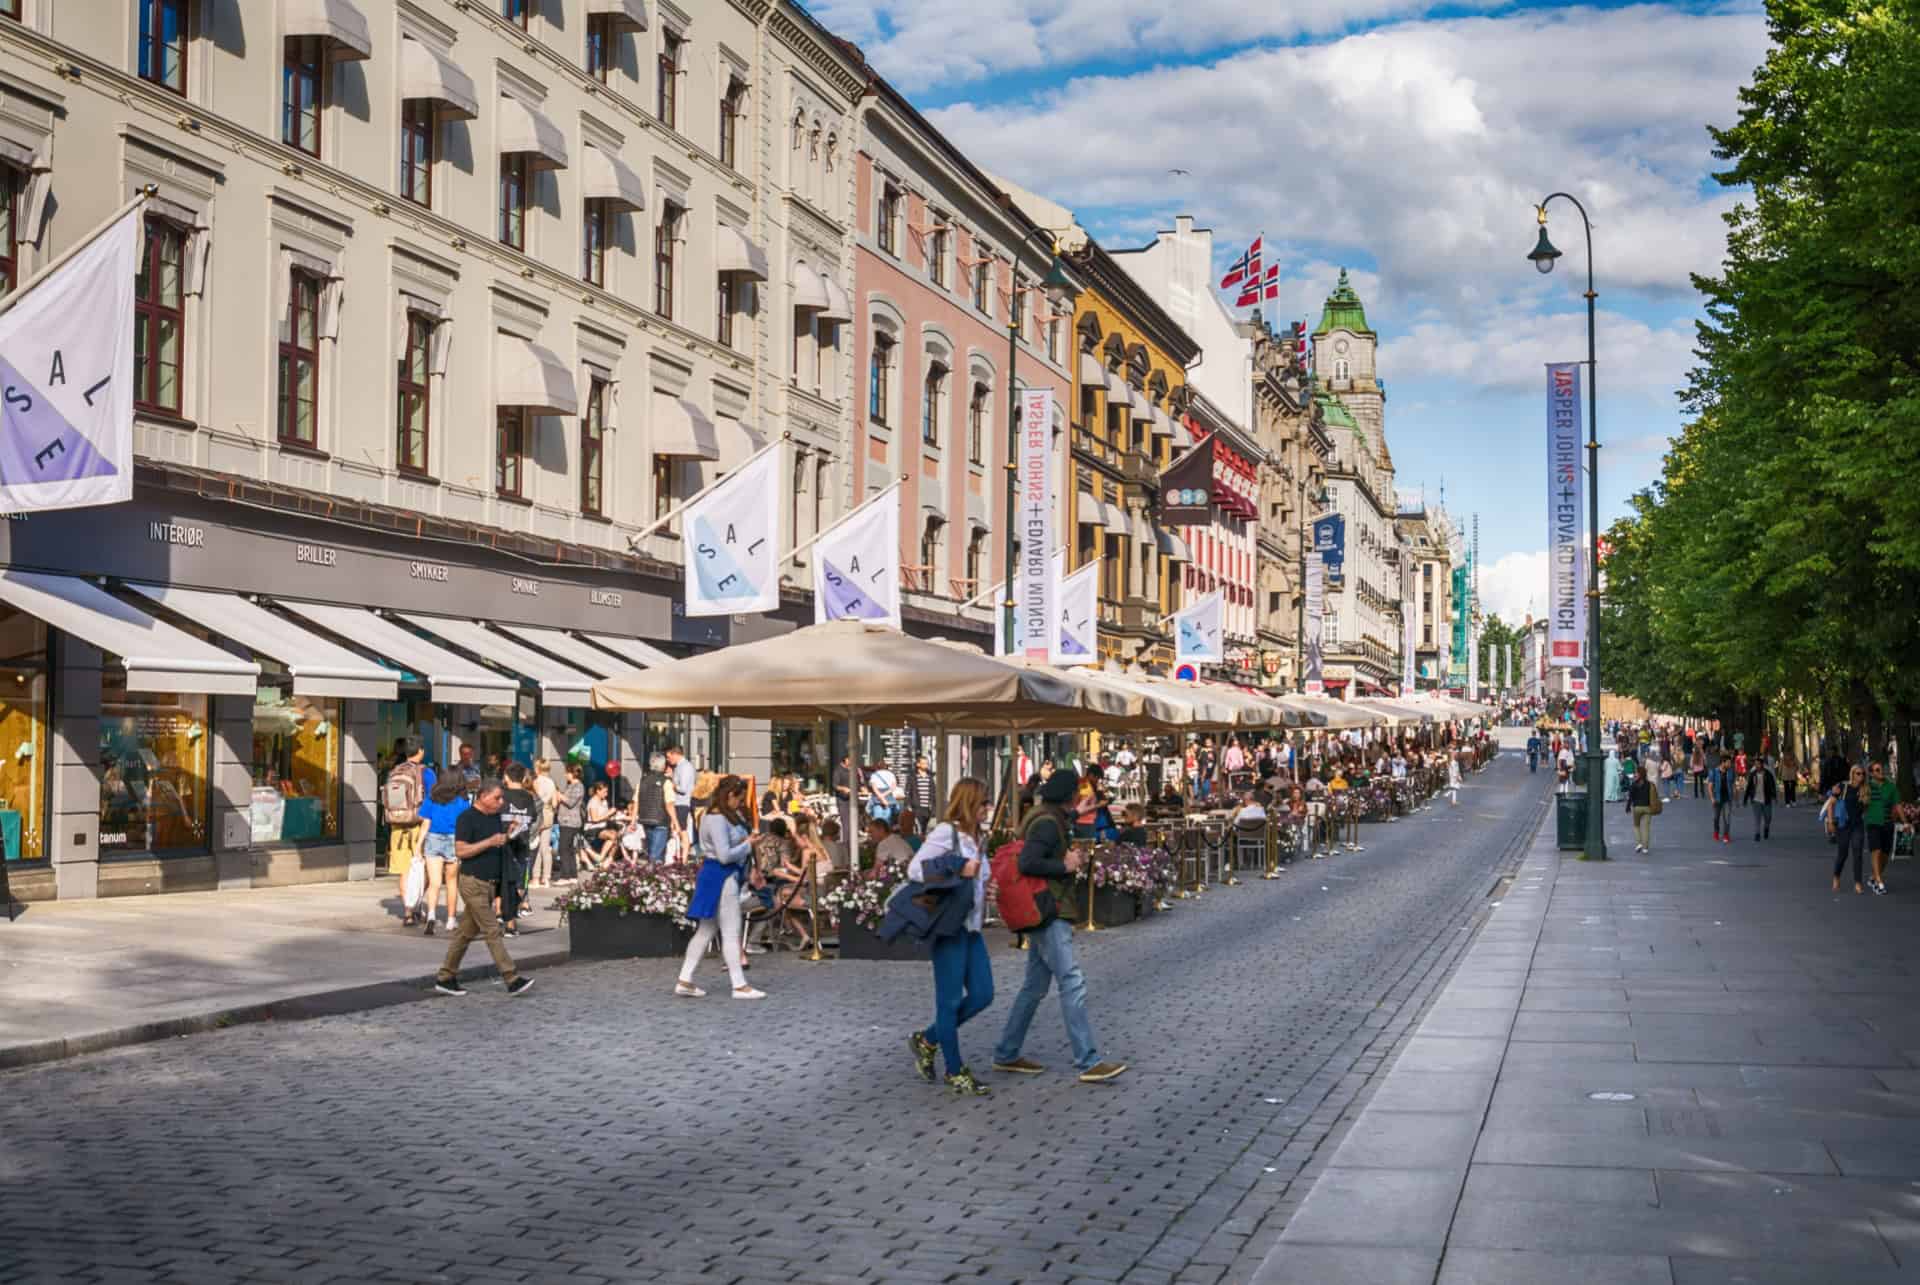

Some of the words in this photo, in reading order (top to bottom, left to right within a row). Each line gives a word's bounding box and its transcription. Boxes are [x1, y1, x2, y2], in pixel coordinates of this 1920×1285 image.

[1555, 371, 1573, 429] JASPER
[150, 522, 204, 546] INTERIØR
[297, 544, 336, 566] BRILLER
[410, 561, 448, 582] SMYKKER
[512, 577, 539, 596] SMINKE
[1558, 571, 1576, 630] MUNCH
